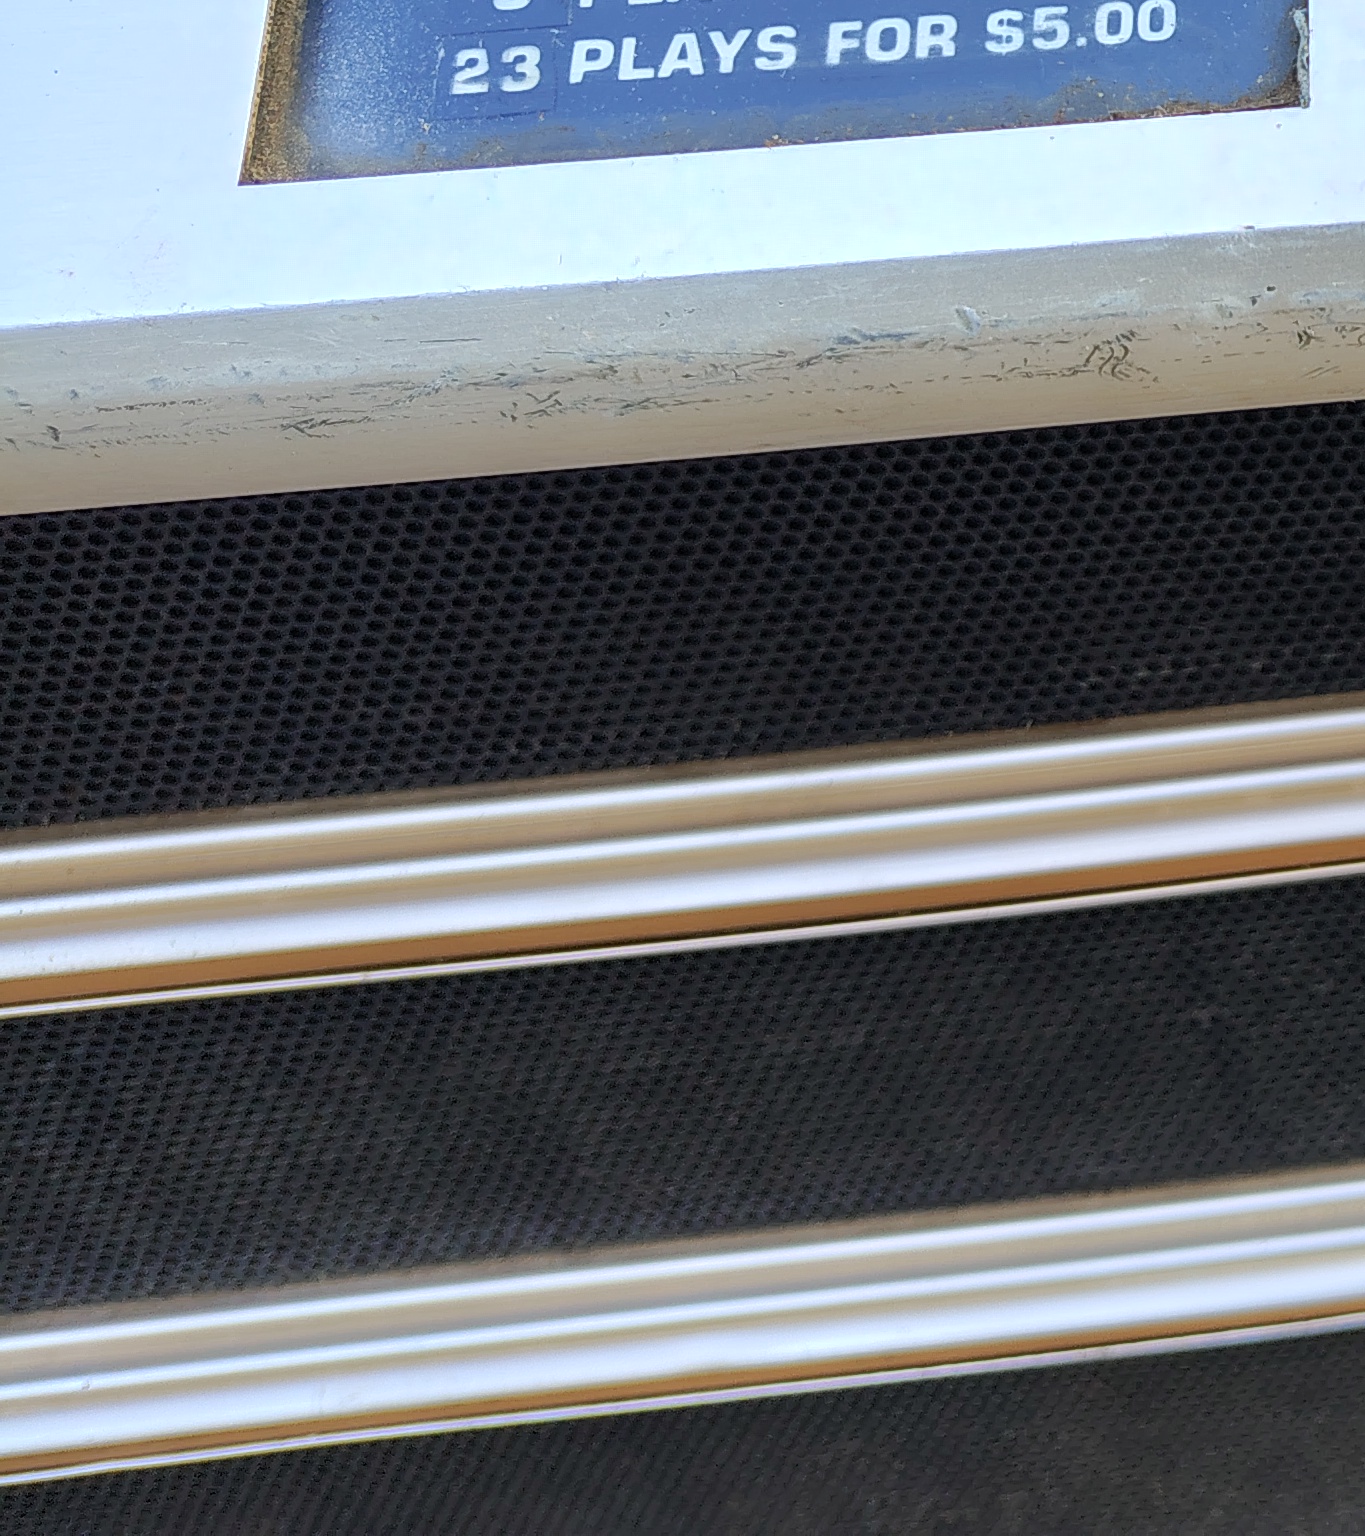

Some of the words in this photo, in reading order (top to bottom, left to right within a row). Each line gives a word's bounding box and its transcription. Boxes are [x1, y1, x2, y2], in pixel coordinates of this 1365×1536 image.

[451, 45, 542, 95] 23
[569, 25, 798, 85] PLAYS
[825, 14, 958, 65] FOR
